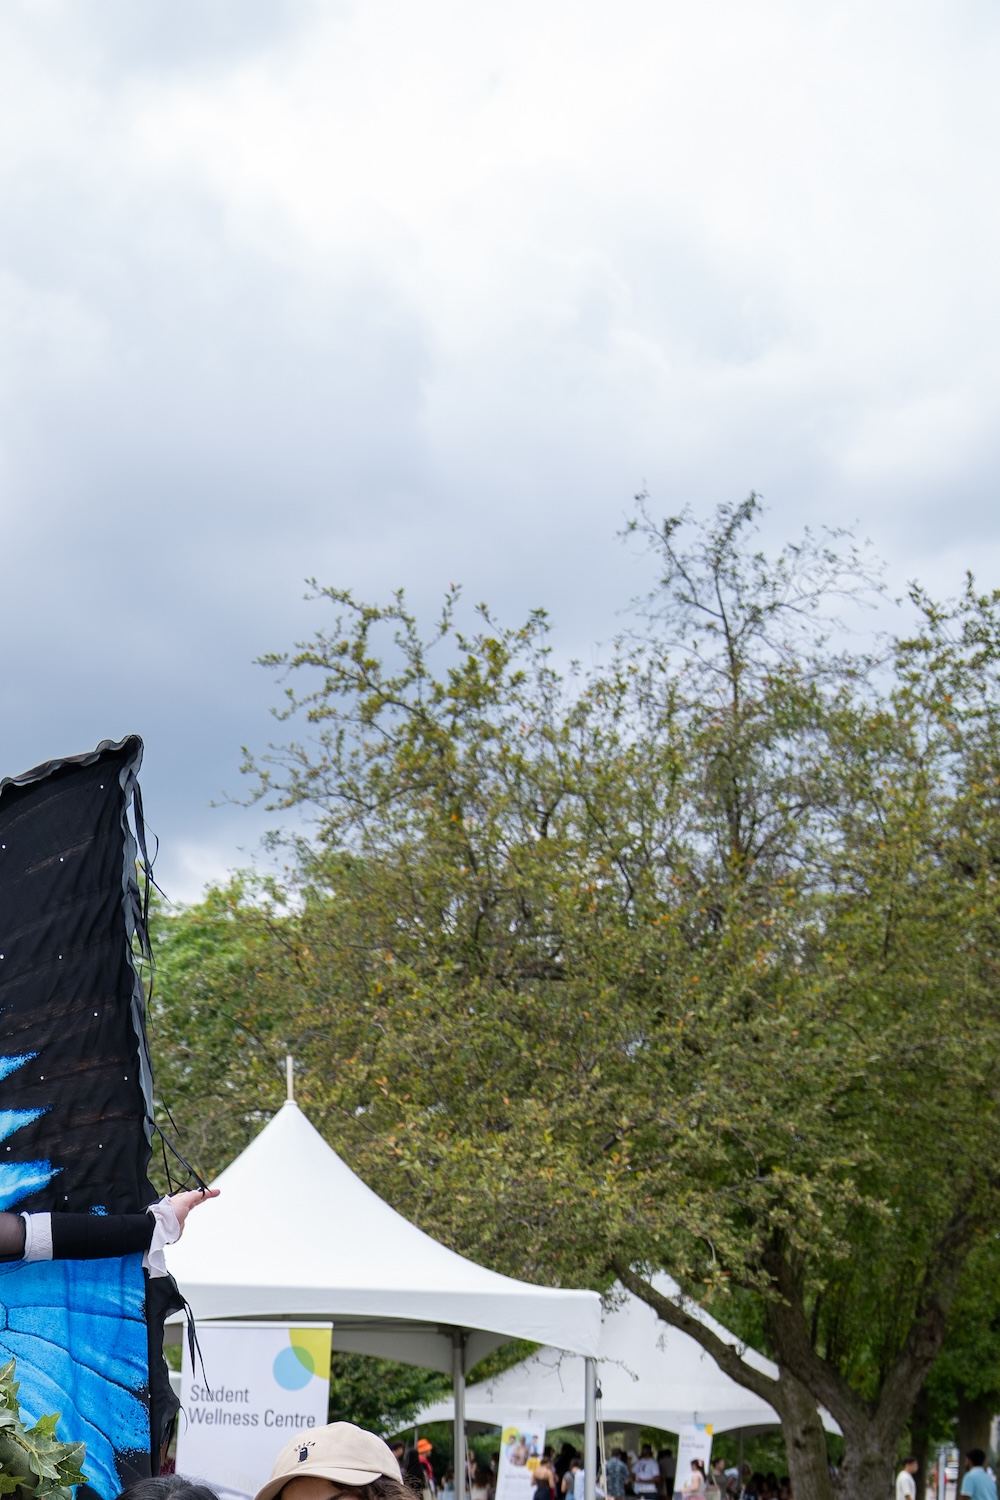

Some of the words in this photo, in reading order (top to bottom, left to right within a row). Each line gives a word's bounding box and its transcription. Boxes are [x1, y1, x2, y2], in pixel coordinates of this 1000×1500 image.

[190, 1384, 250, 1403] Student
[188, 1407, 259, 1427] Wellness
[264, 1409, 316, 1429] Centre
